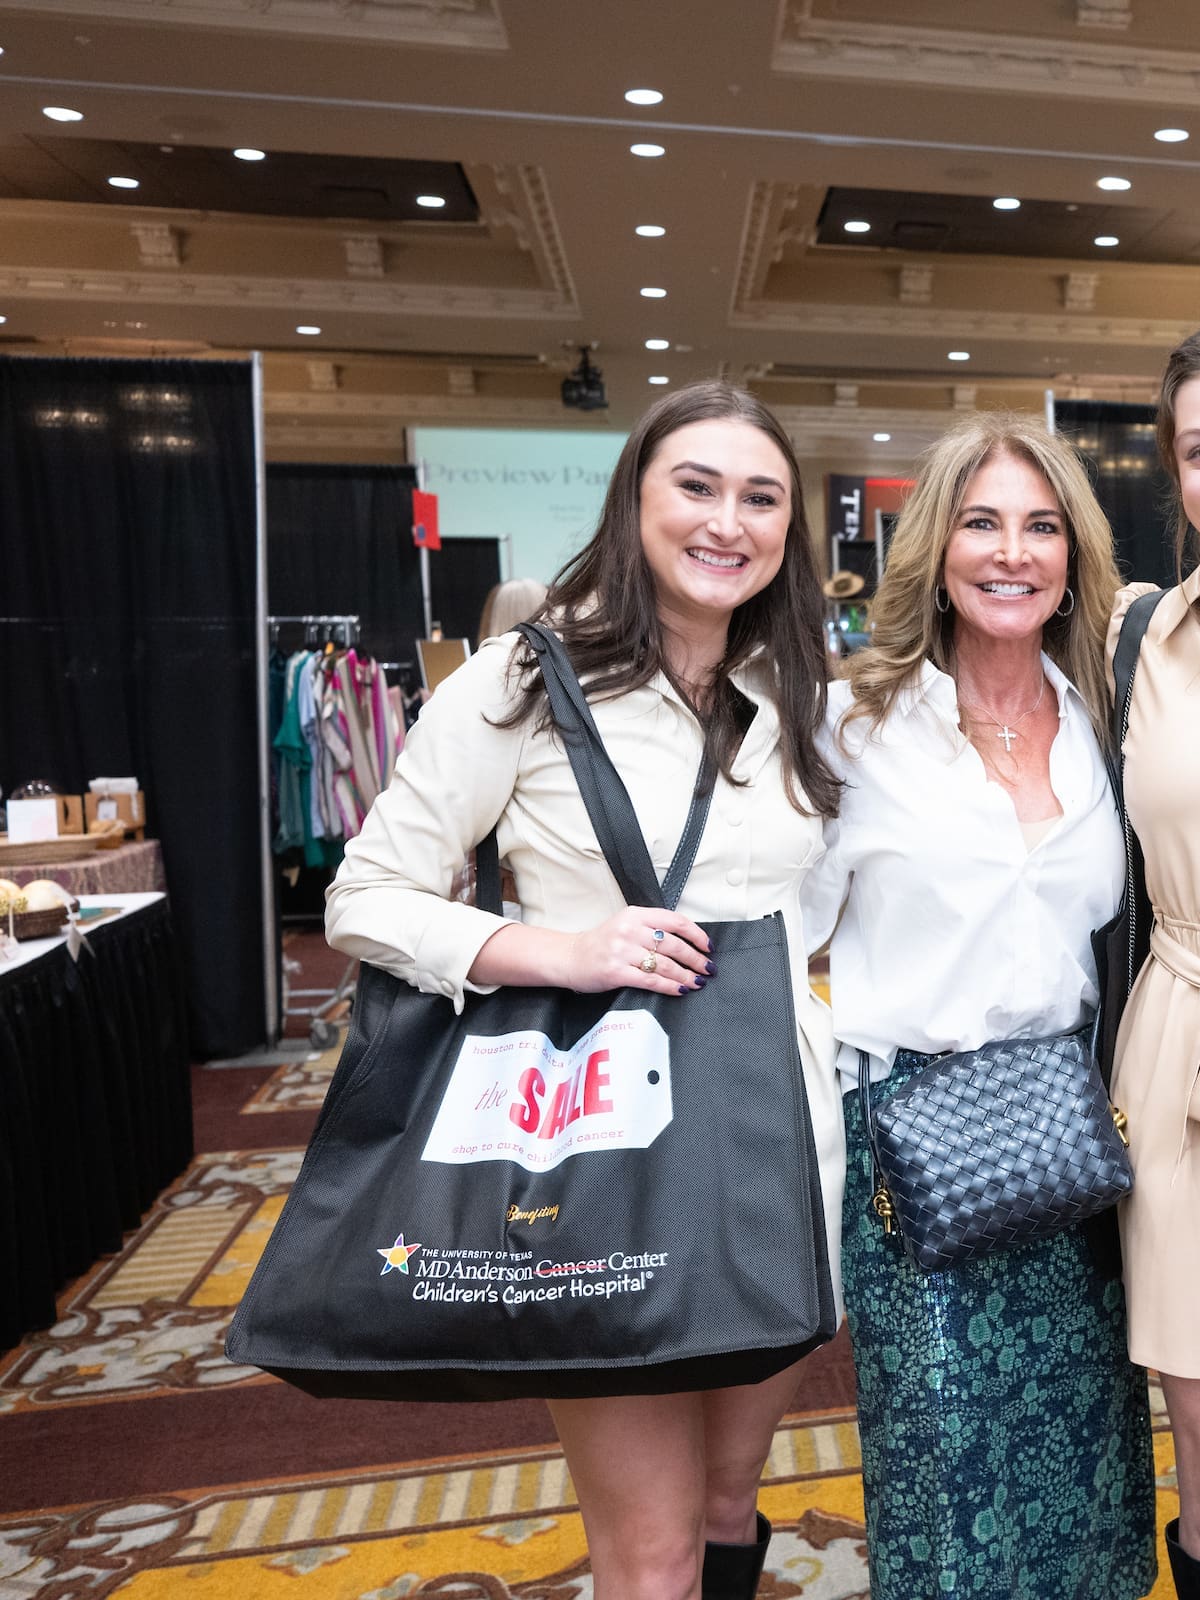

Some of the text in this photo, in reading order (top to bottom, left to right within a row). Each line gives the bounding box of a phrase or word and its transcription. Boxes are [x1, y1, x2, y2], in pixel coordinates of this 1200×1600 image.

[426, 464, 554, 485] Preview
[473, 1042, 514, 1055] houston
[519, 1040, 537, 1051] tri
[475, 1082, 507, 1110] the
[509, 1049, 614, 1139] SALE
[452, 1144, 478, 1155] shop
[482, 1142, 492, 1152] to
[497, 1142, 525, 1154] cure
[576, 1129, 624, 1144] cancer
[506, 1204, 560, 1225] Benefiting
[422, 1249, 533, 1260] THE UNIVERSITY OF TEXAS
[416, 1252, 668, 1281] MD Anderson Cancer Center
[413, 1282, 498, 1302] Children's
[503, 1285, 564, 1304] Cancer
